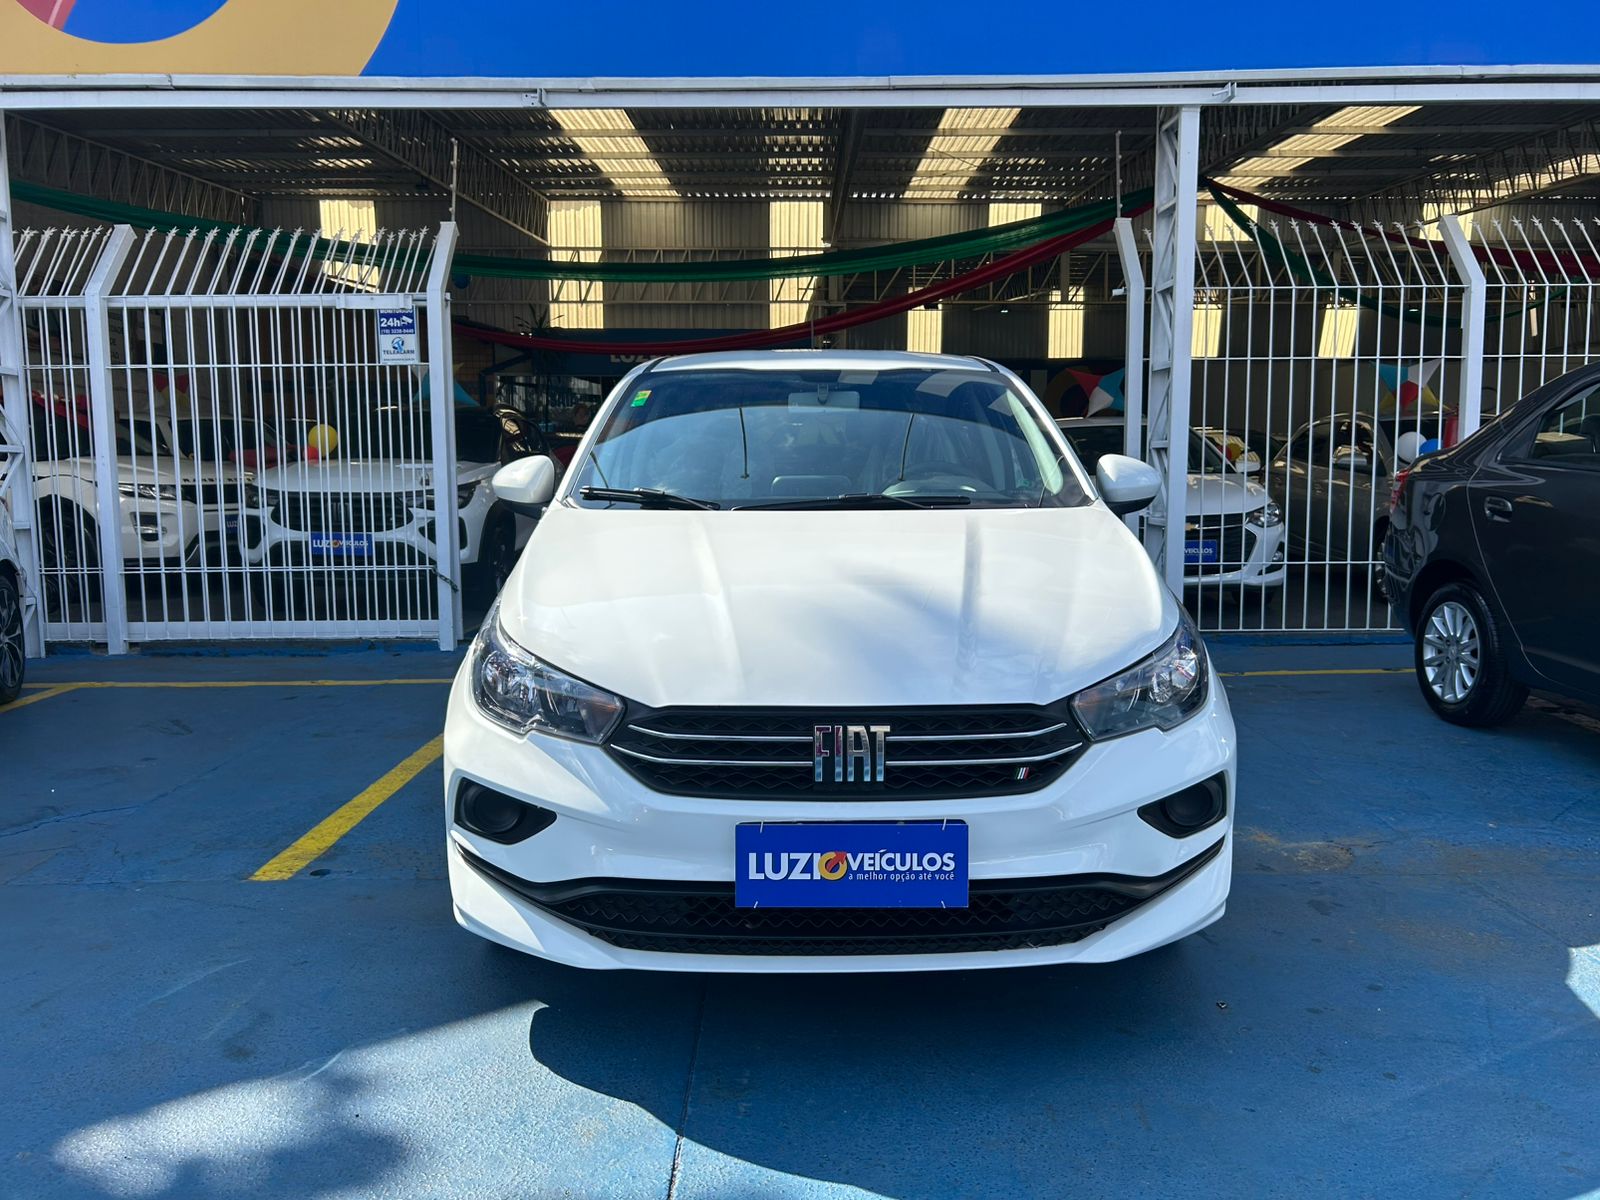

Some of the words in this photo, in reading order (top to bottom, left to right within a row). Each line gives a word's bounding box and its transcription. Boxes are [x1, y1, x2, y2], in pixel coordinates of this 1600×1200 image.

[380, 317, 400, 327] 24h
[814, 725, 891, 782] FIAT
[748, 851, 848, 881] LUZIO
[847, 849, 955, 871] VEÍCULOS
[856, 871, 887, 881] melhor
[890, 872, 915, 883] opção
[918, 871, 932, 881] até
[935, 871, 955, 881] você
